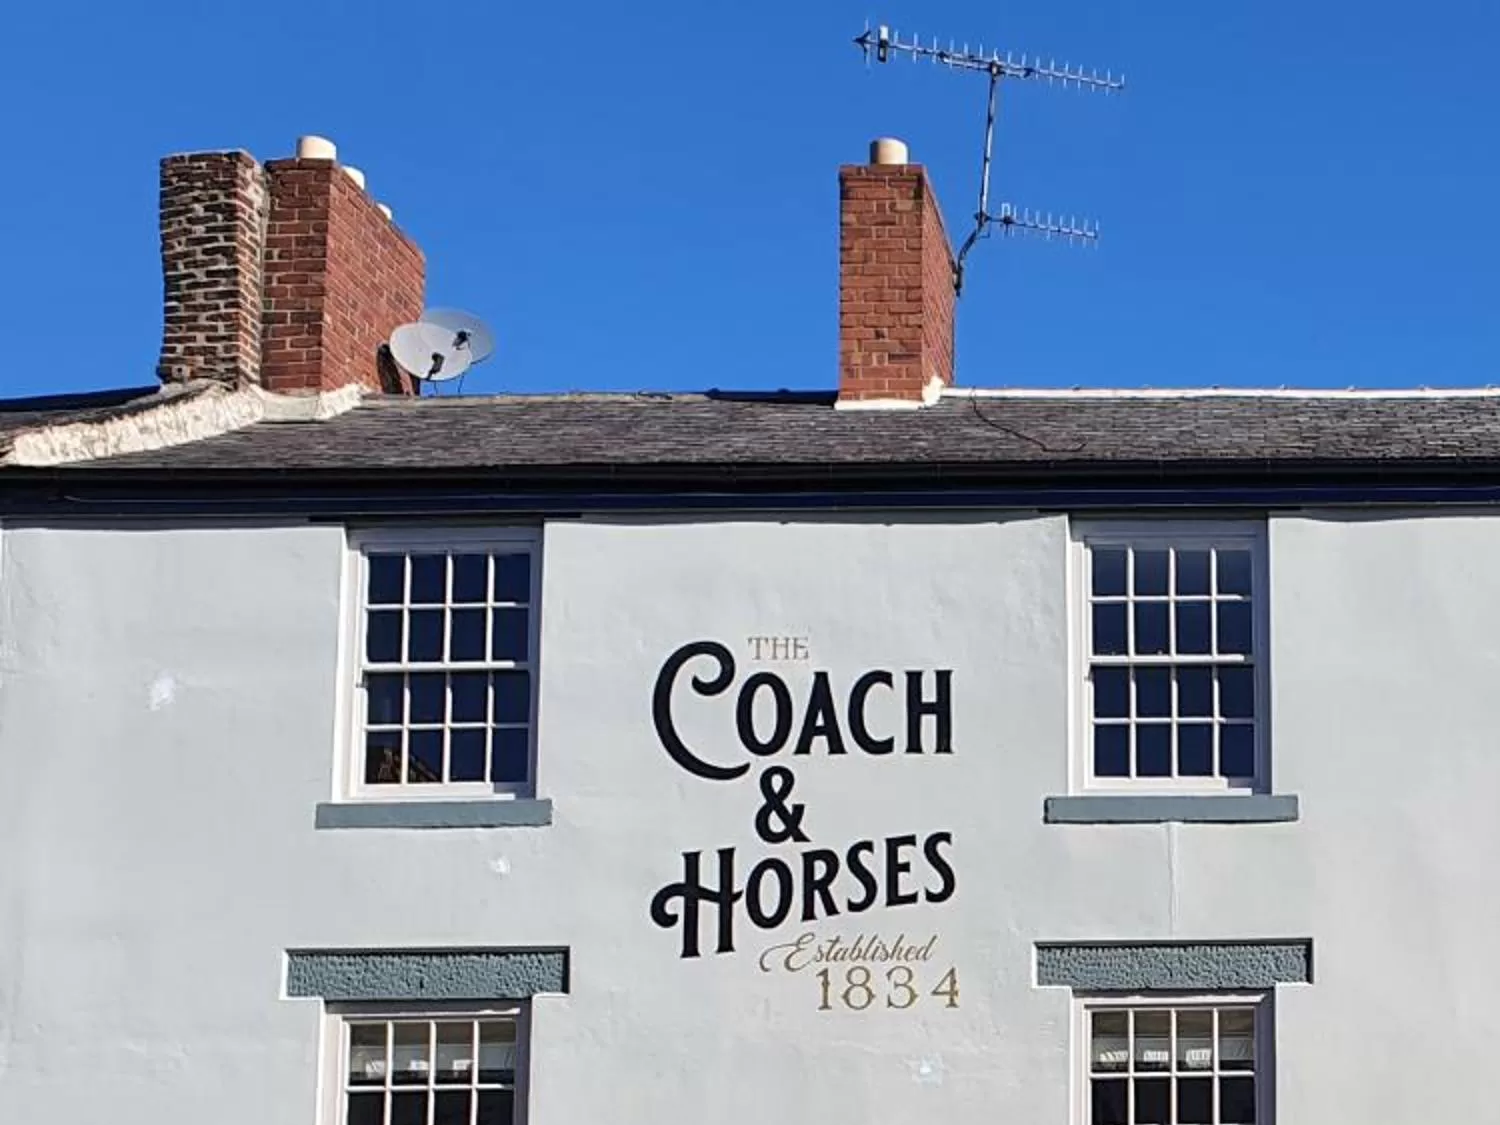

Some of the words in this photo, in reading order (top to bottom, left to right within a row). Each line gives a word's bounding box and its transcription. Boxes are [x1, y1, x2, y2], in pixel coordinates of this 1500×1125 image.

[748, 637, 810, 661] THE
[651, 640, 955, 780] COACH
[754, 765, 811, 844] &
[650, 831, 956, 958] HORSES
[759, 932, 939, 974] Established
[815, 965, 960, 1011] 1834
